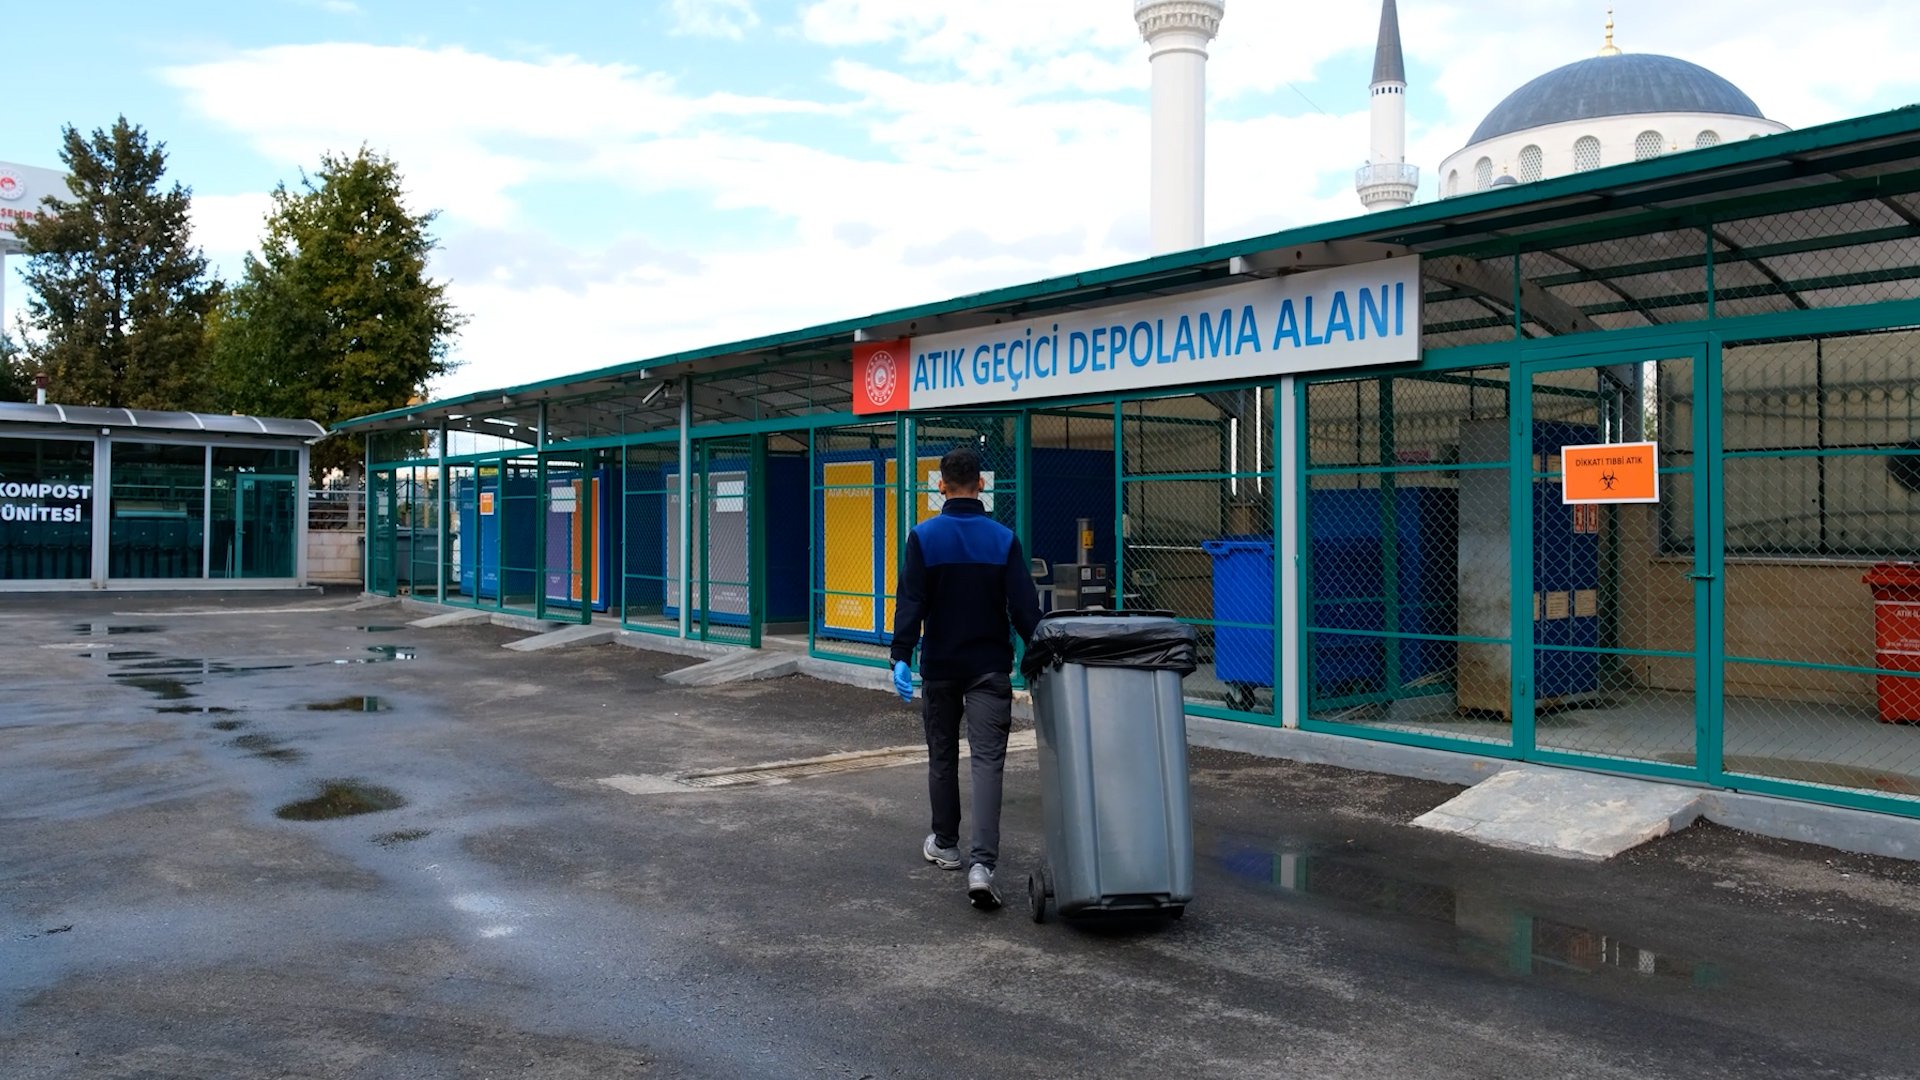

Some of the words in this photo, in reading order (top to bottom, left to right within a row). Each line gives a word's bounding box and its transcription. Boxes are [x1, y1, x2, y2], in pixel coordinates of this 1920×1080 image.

[913, 348, 965, 392] ATIK
[973, 323, 1058, 392] GEÇİCİ
[1069, 304, 1261, 371] DEPOLAMA
[1273, 281, 1405, 351] ALANI
[1626, 456, 1643, 464] ATIK
[0, 482, 91, 499] KOMPOST
[1, 503, 81, 522] ÜNİTESİ
